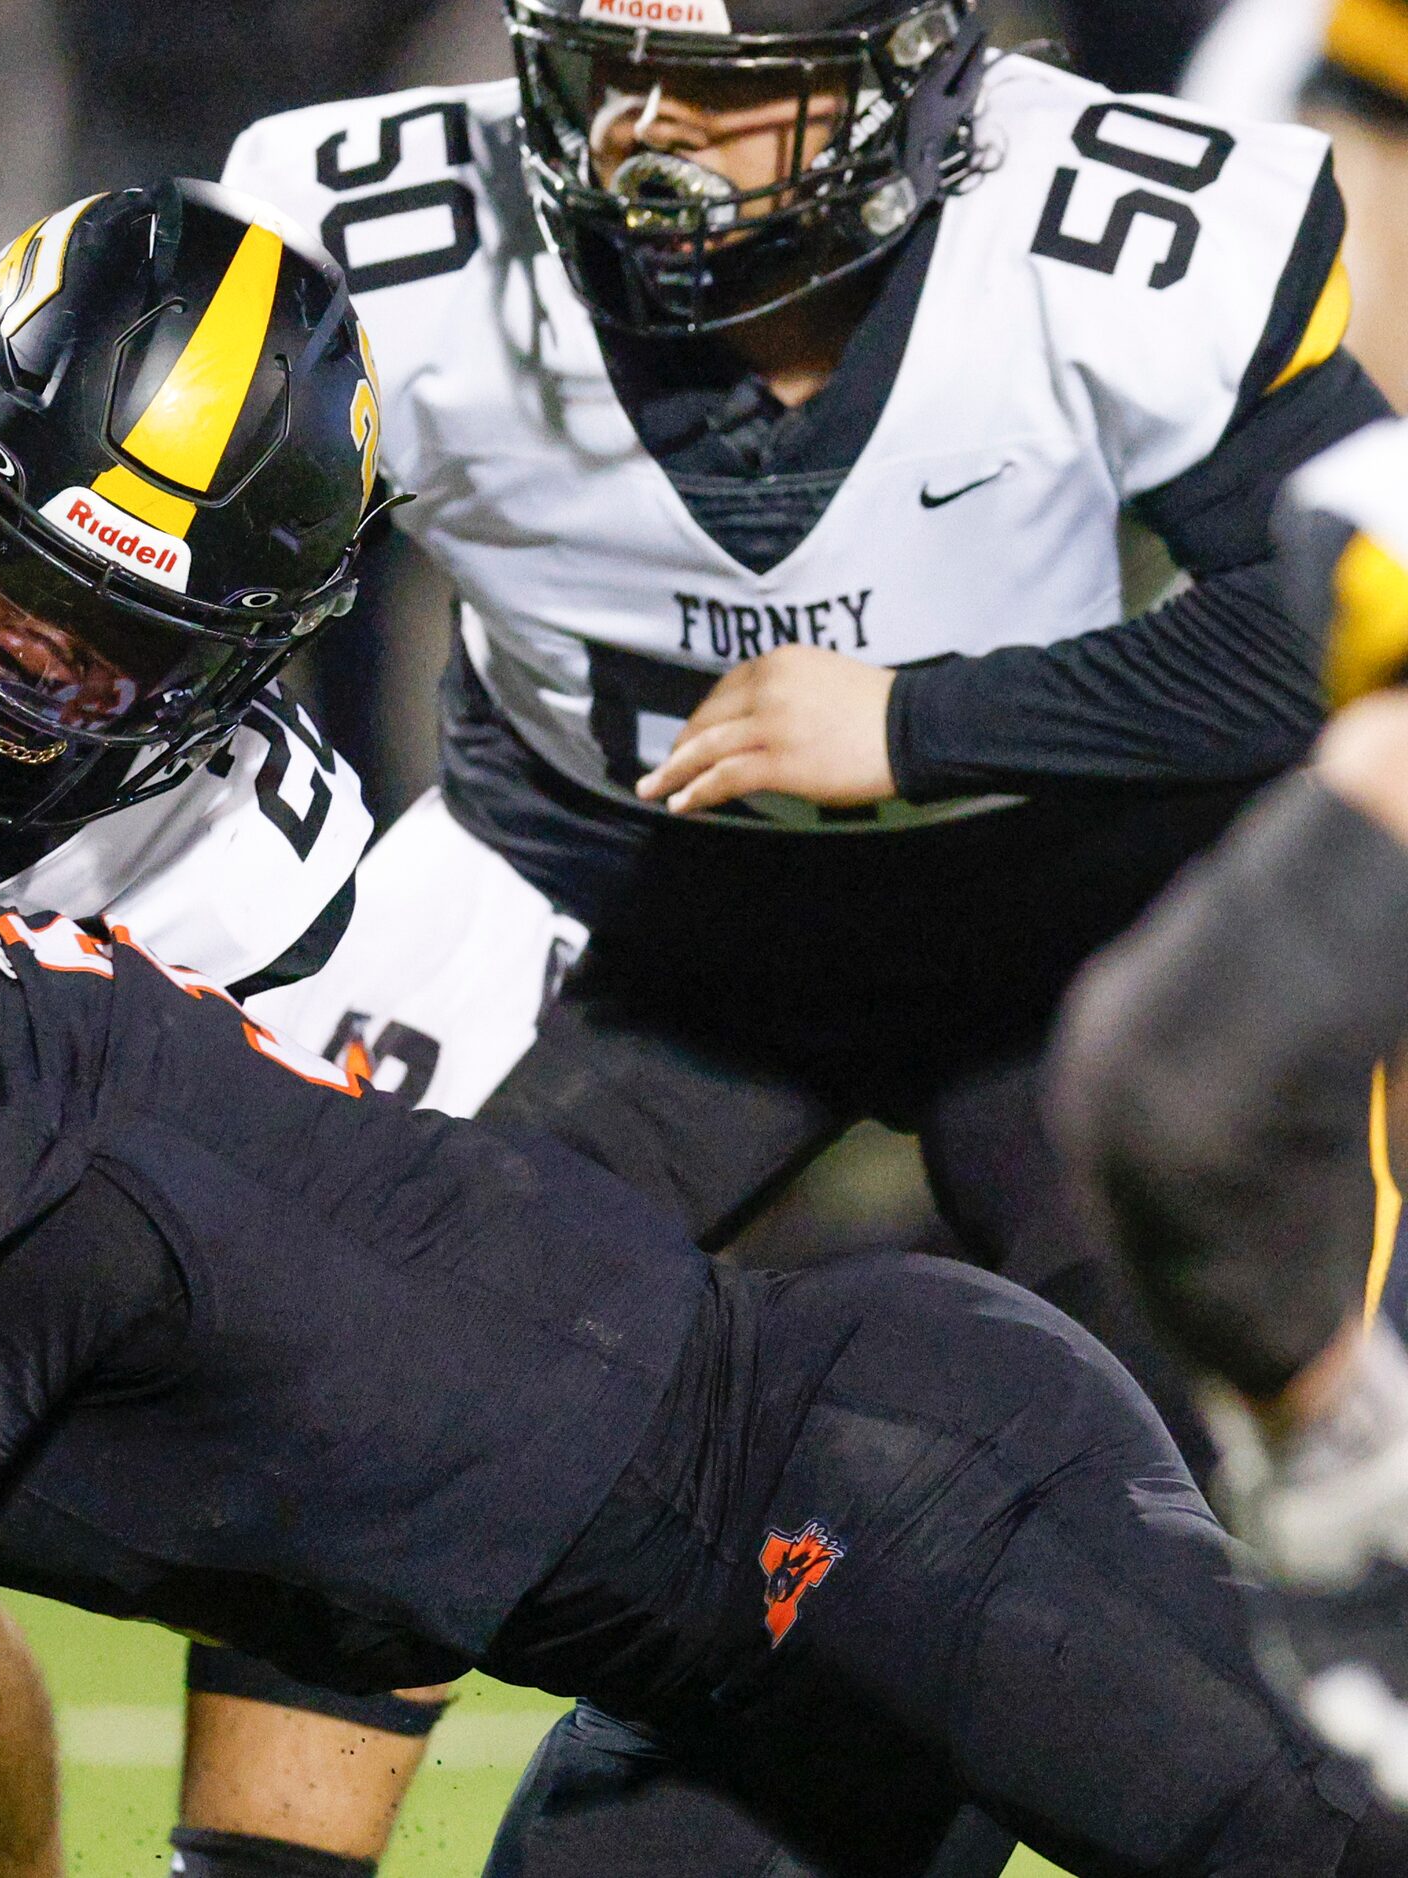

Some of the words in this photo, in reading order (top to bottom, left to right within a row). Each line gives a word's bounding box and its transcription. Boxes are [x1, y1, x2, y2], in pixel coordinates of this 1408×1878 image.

[316, 99, 483, 296] 50
[1030, 102, 1237, 290] 50
[66, 498, 178, 574] Riddell
[673, 589, 873, 658] FORNEY
